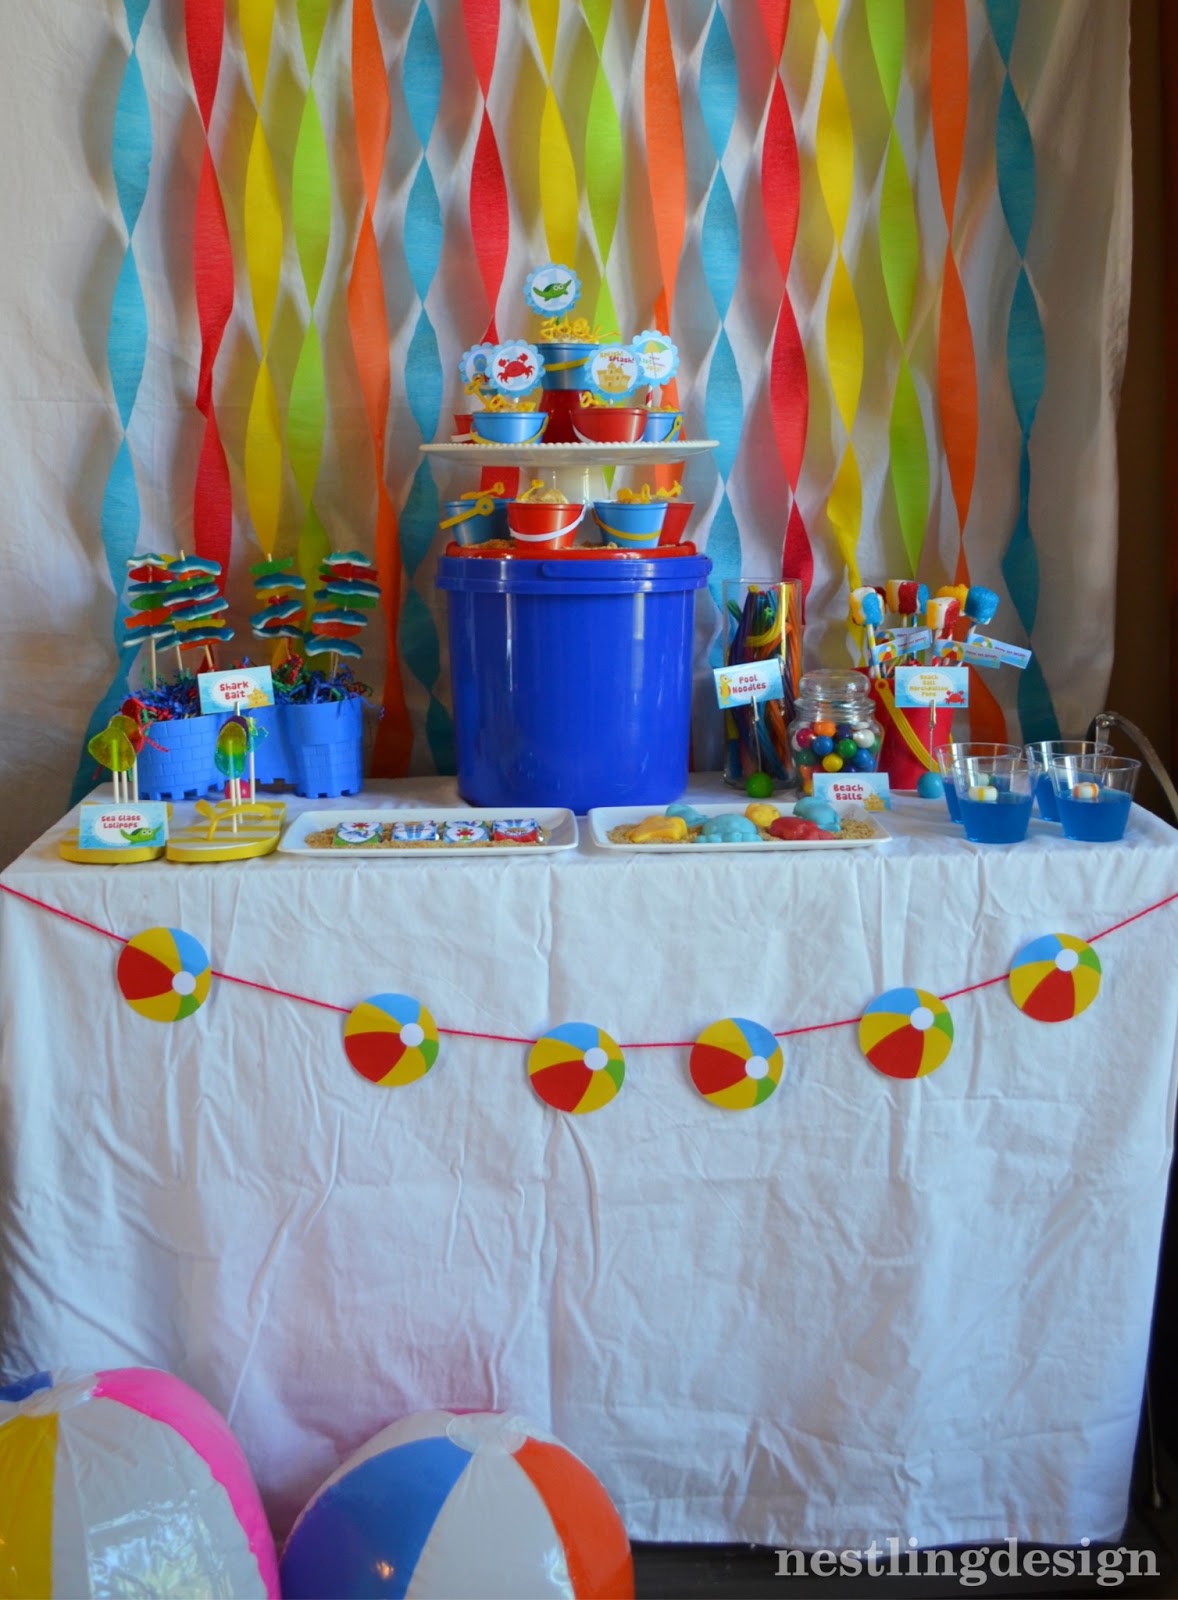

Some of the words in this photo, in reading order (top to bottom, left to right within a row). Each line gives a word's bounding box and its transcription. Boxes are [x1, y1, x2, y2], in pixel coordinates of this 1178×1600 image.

[738, 674, 758, 684] Pool
[219, 681, 249, 692] Shark
[732, 682, 767, 694] Noodles
[224, 691, 246, 700] Bait
[833, 784, 864, 792] Beach
[835, 792, 863, 801] Balls
